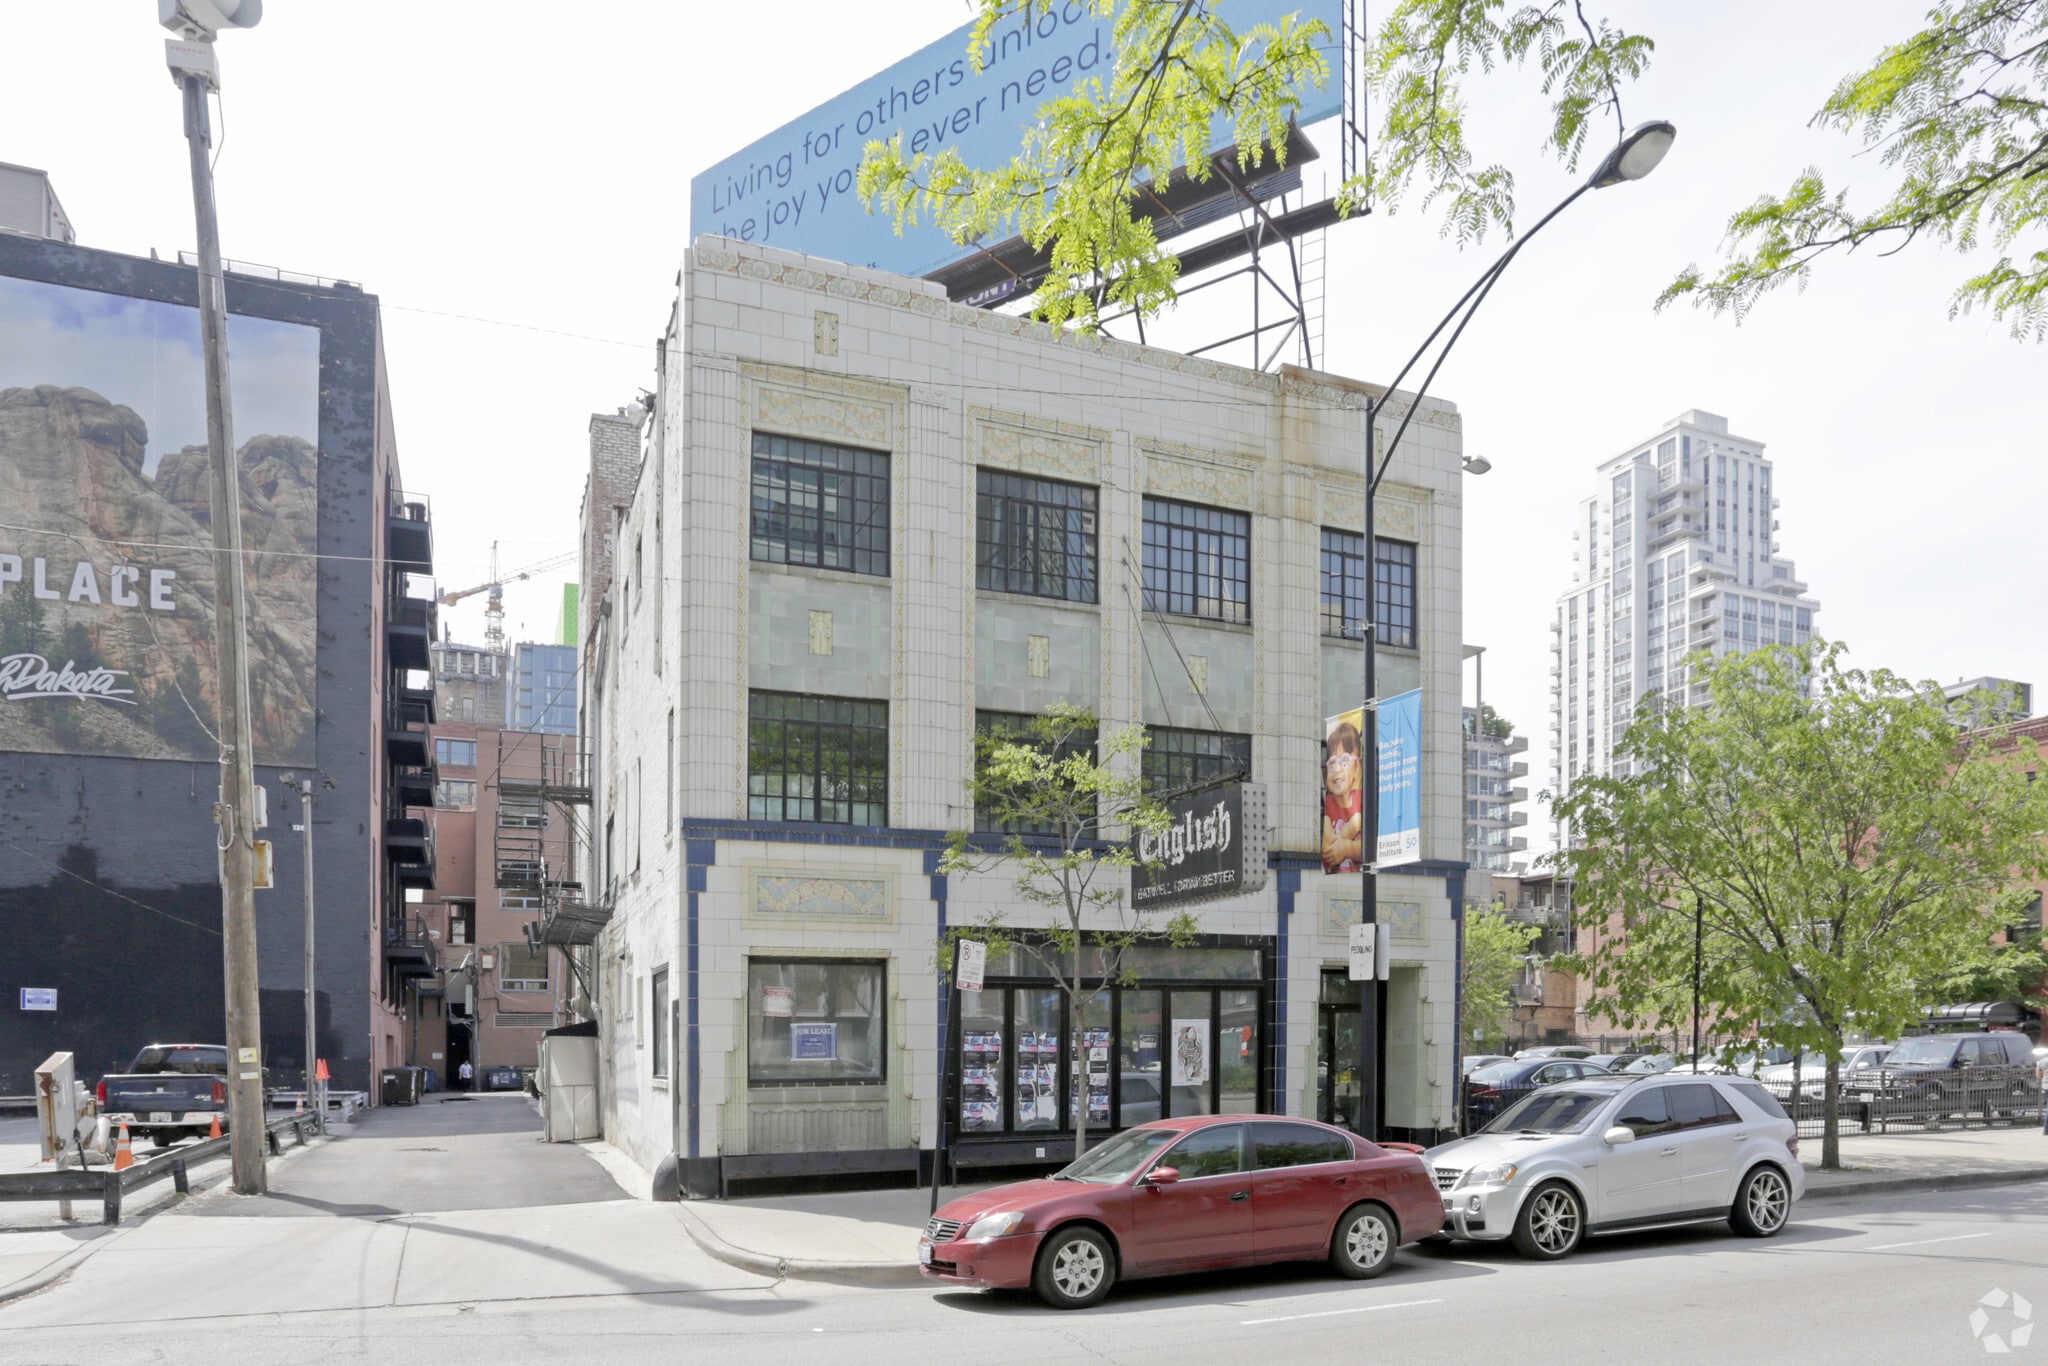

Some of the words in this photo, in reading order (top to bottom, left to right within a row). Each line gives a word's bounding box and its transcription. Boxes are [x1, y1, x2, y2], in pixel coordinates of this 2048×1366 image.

[713, 152, 792, 213] Living
[803, 123, 845, 164] for
[856, 59, 964, 135] others
[714, 218, 756, 241] he
[763, 190, 807, 241] joy
[911, 96, 987, 155] ever
[1001, 27, 1112, 112] need.
[0, 554, 176, 611] PLACE
[1406, 836, 1417, 849] 50
